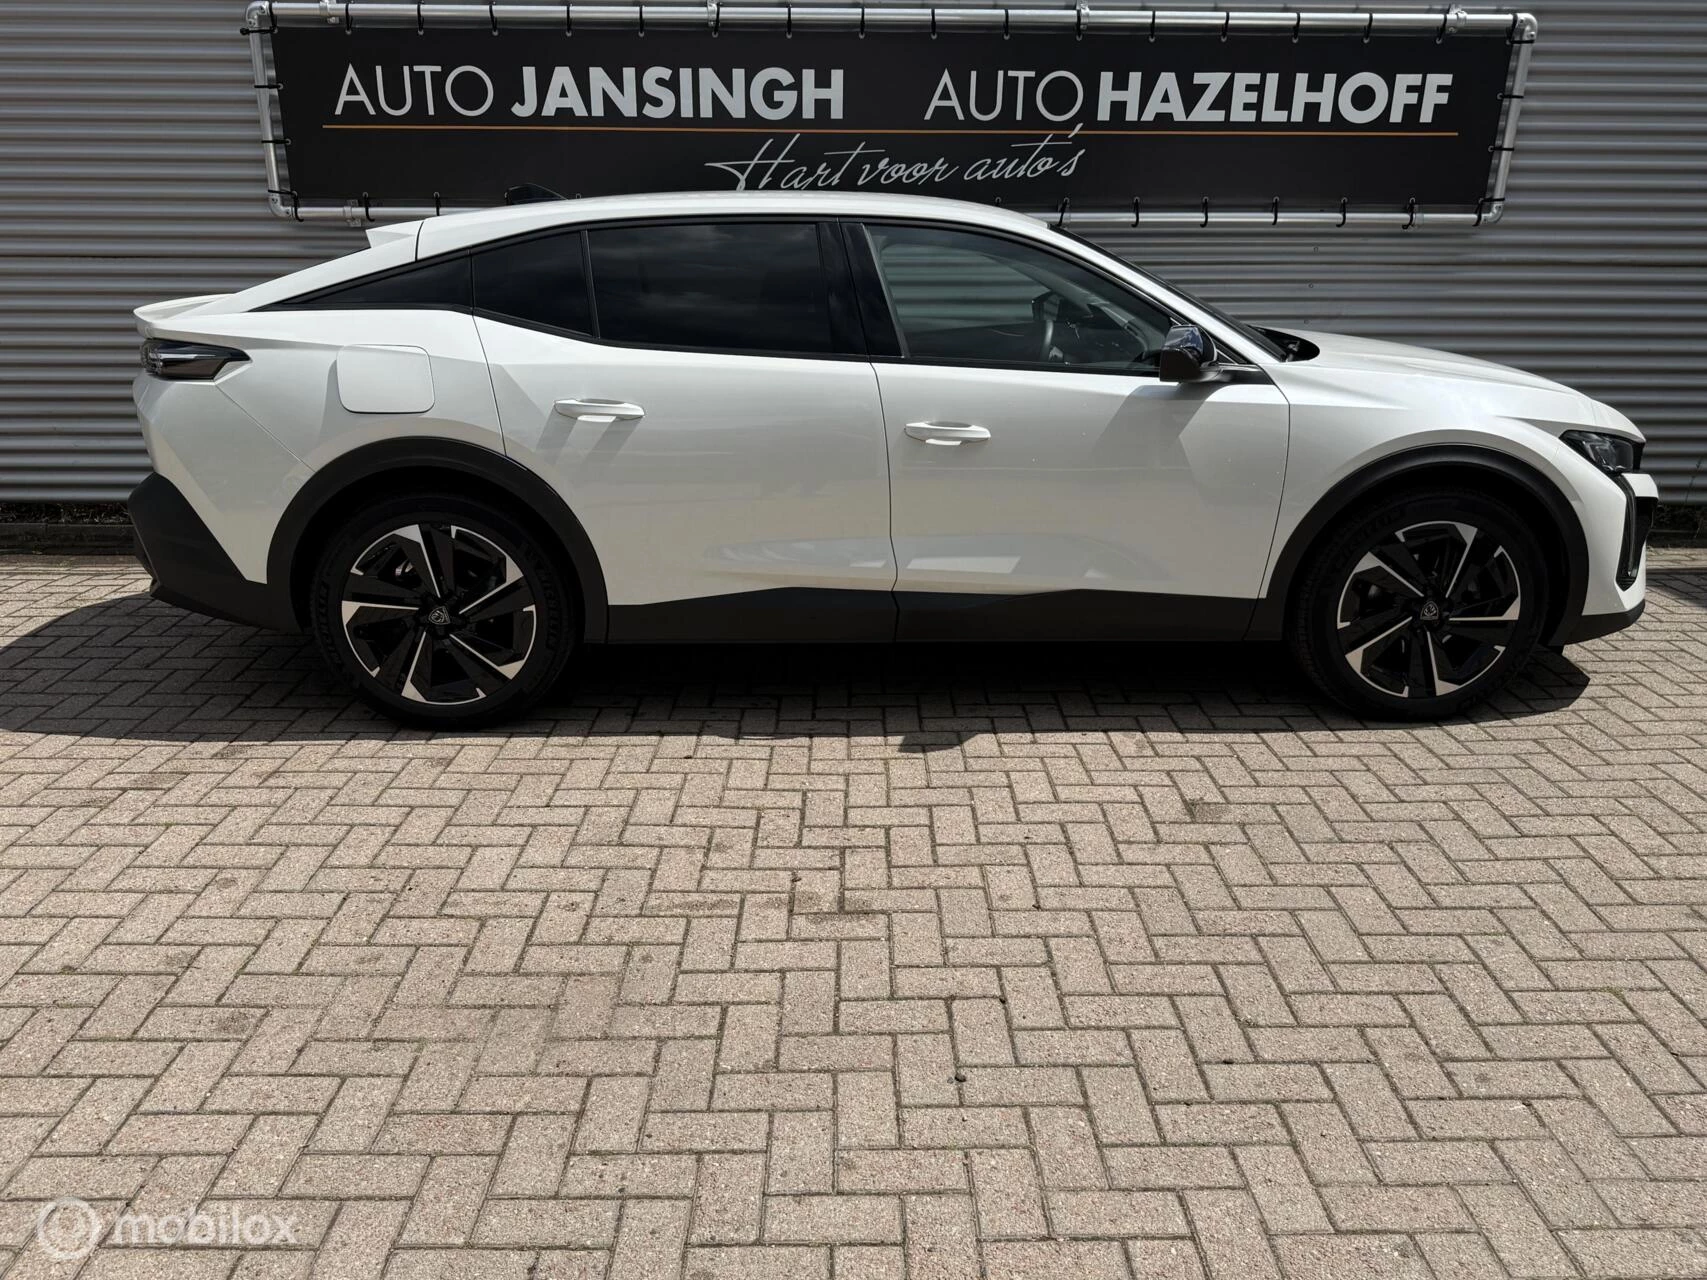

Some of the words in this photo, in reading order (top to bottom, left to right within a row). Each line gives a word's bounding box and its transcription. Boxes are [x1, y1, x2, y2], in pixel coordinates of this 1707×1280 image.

[334, 63, 494, 117] AUTO
[510, 66, 844, 121] JANSINGH
[923, 69, 1084, 122] AUTO
[1096, 71, 1454, 124] HAZELHOFF
[704, 133, 885, 191] Hart
[858, 156, 959, 186] voor
[963, 123, 1086, 181] auto's
